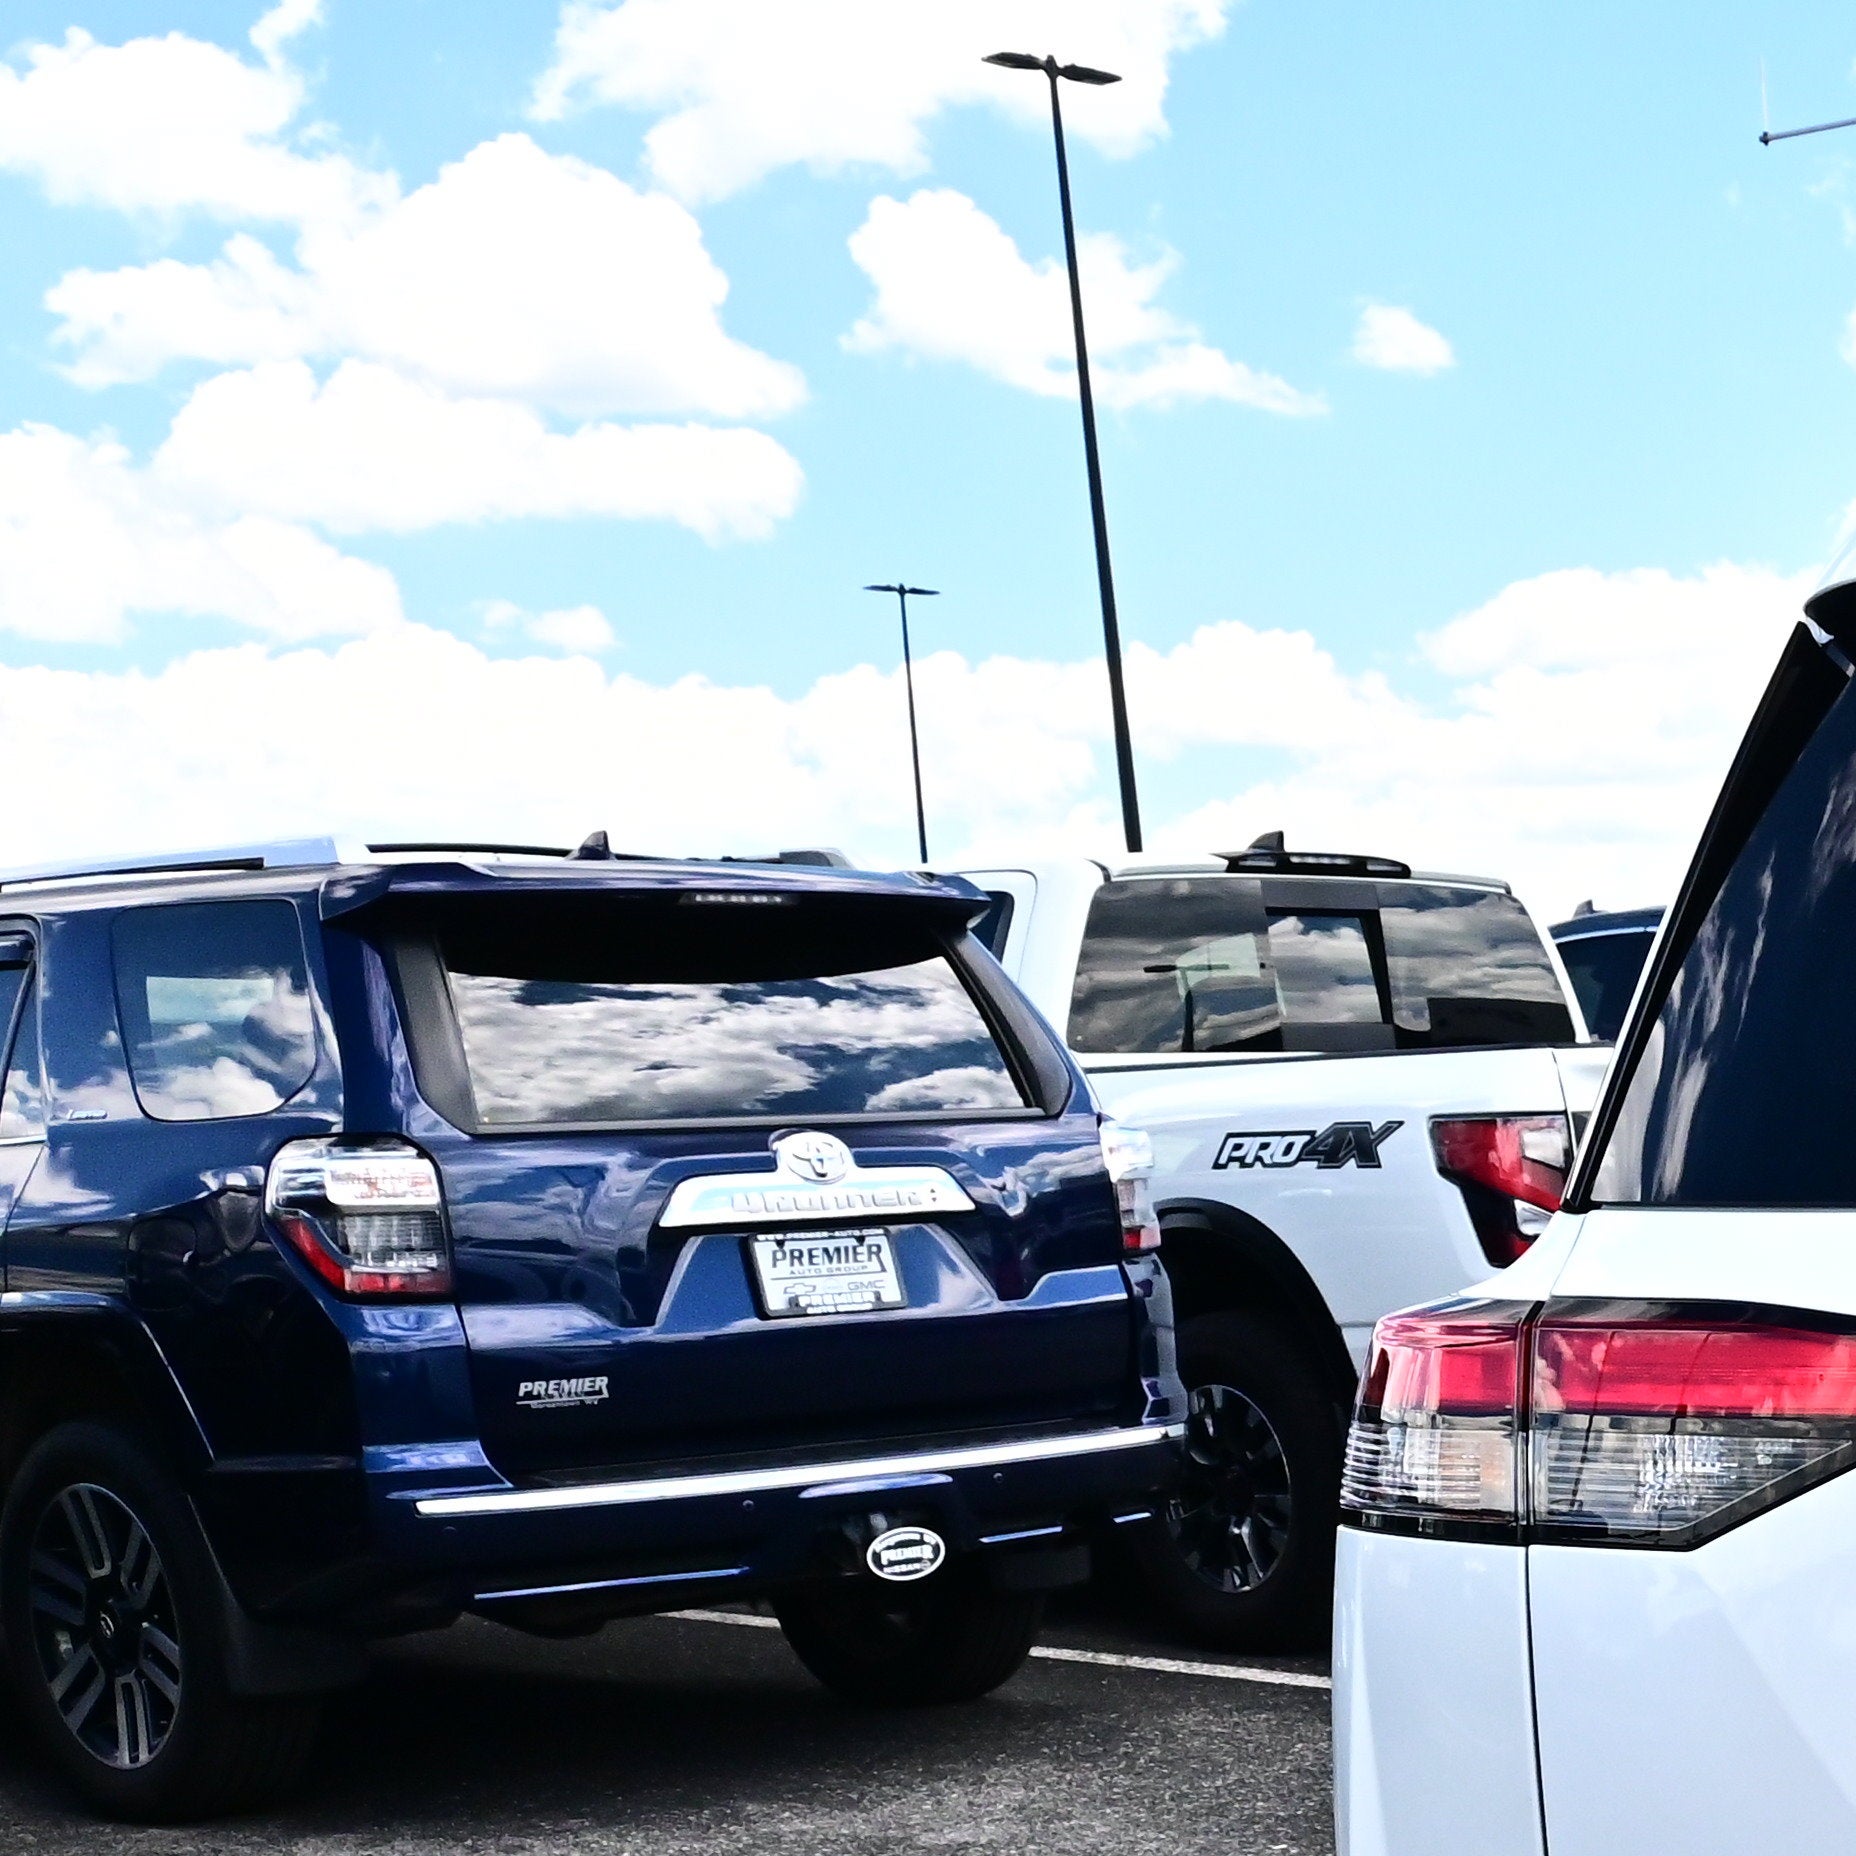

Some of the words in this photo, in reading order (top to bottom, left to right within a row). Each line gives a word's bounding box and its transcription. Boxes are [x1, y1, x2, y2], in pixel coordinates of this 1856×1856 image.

[771, 1243, 887, 1274] PREMIER
[789, 1267, 821, 1275] AUTO
[826, 1264, 869, 1273] GROUP
[847, 1279, 886, 1291] GMC
[518, 1376, 609, 1398] PREMIER
